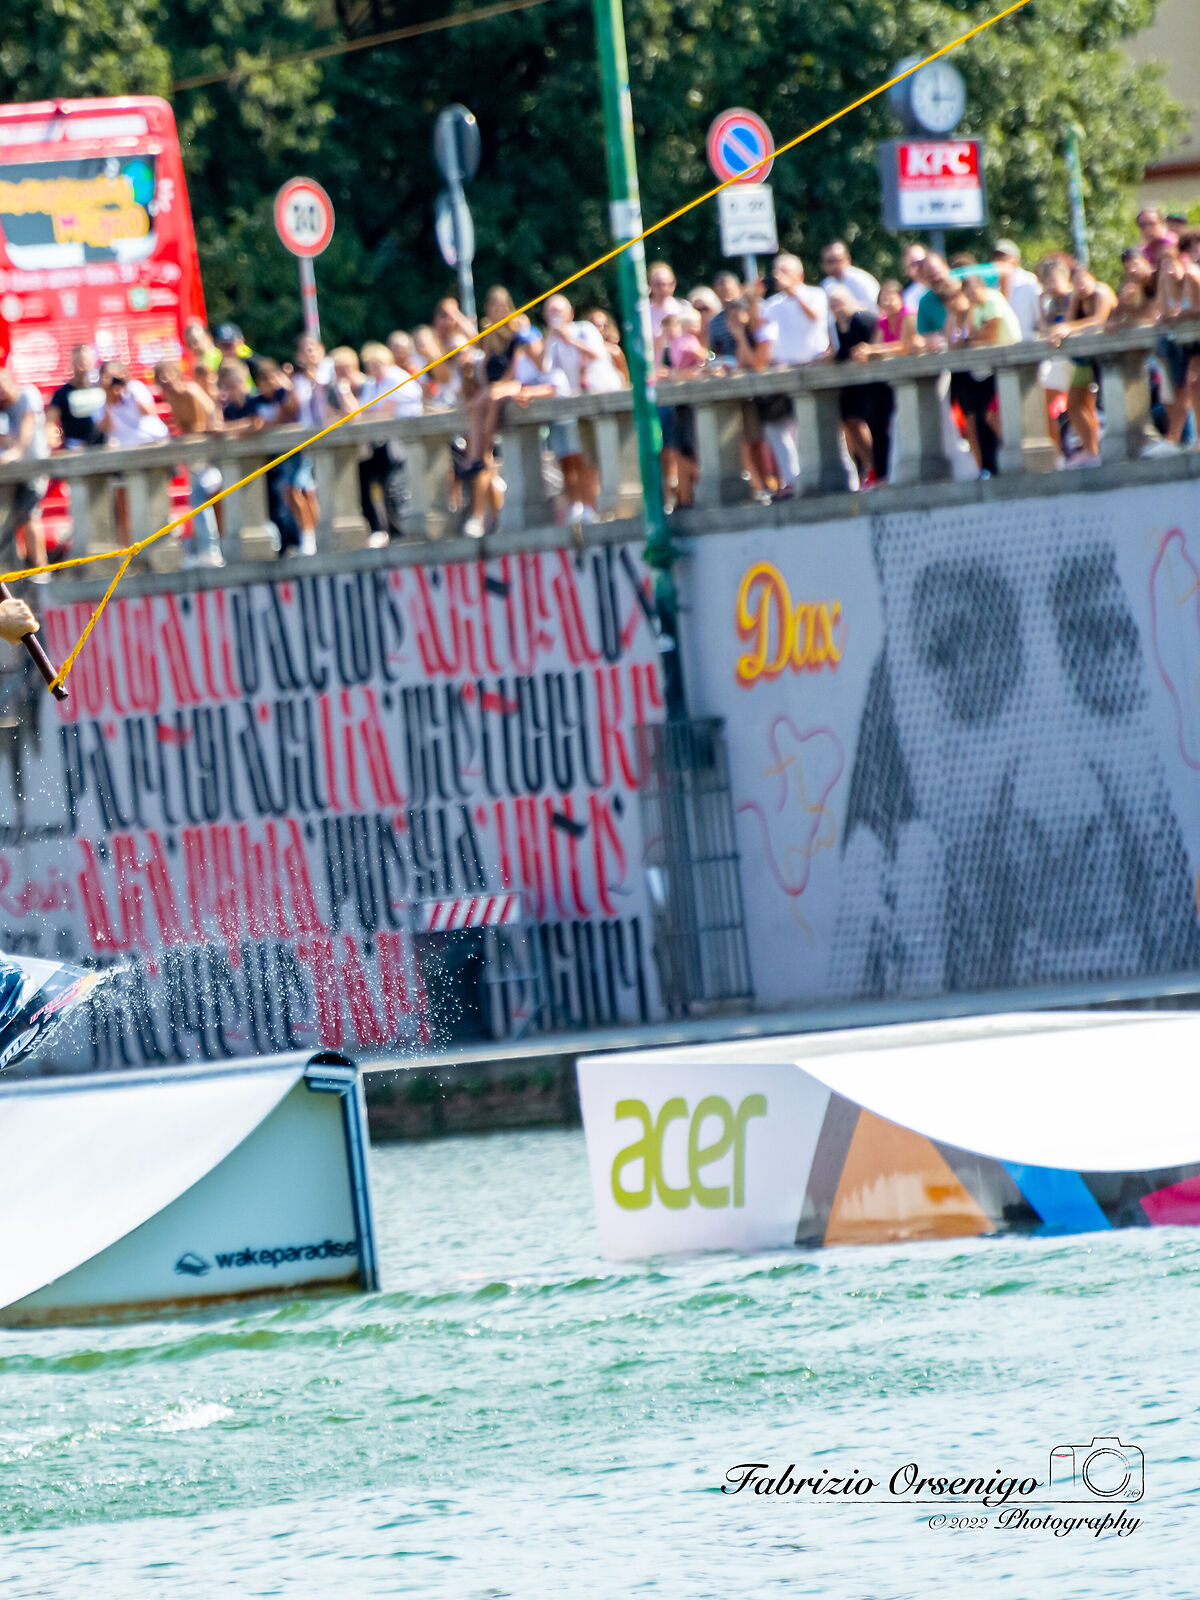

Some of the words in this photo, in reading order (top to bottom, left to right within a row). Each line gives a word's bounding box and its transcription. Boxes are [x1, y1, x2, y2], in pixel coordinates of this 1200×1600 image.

[909, 144, 971, 176] KFC
[735, 560, 847, 690] Dax
[611, 1093, 767, 1211] acer
[214, 1239, 359, 1269] wakeparadise
